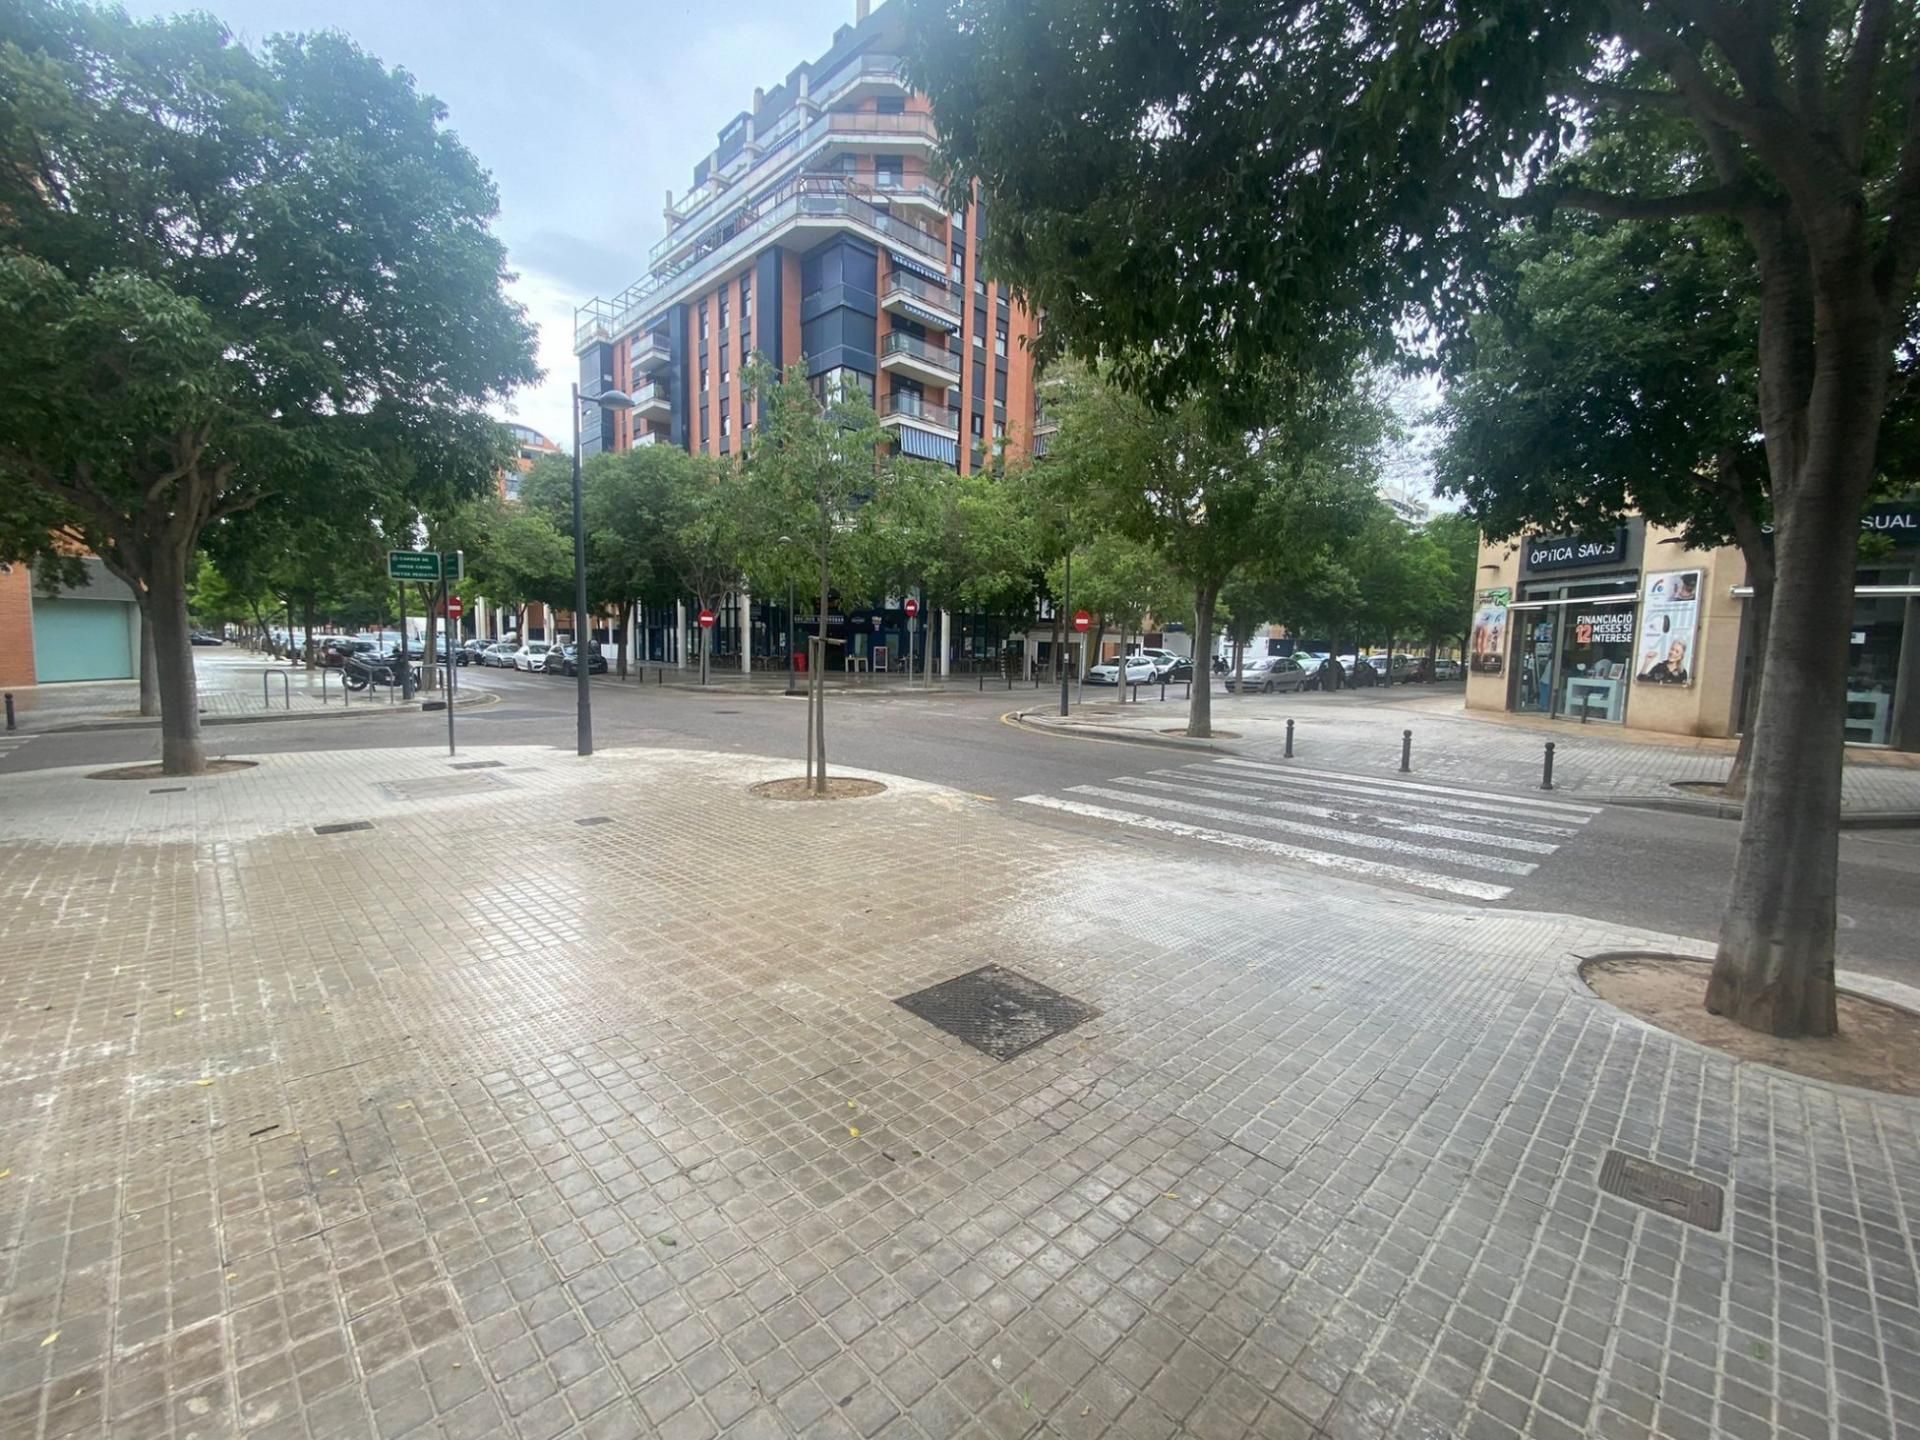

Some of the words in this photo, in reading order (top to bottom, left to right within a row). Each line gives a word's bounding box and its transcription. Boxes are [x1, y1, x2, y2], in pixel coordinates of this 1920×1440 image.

[1578, 543, 1615, 558] SAVS
[1576, 624, 1592, 643] 12
[1593, 624, 1621, 633] MESES
